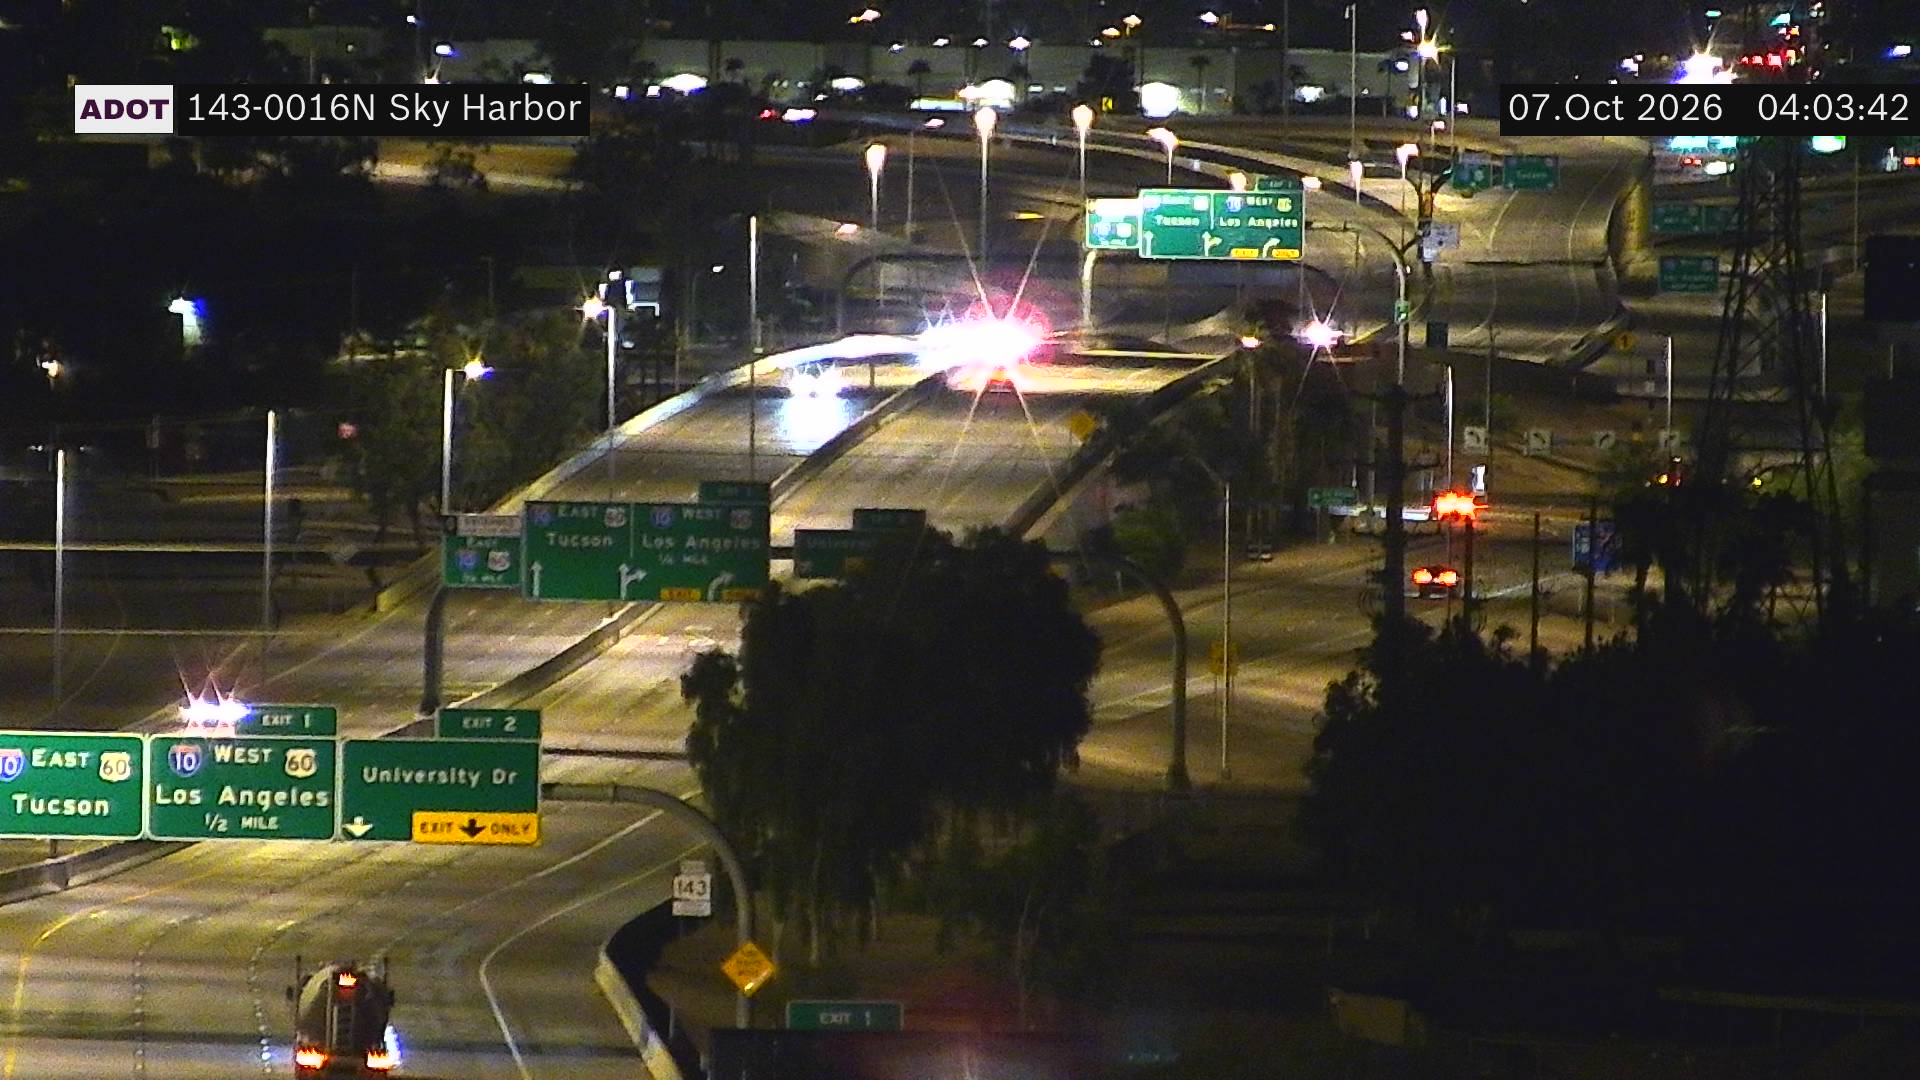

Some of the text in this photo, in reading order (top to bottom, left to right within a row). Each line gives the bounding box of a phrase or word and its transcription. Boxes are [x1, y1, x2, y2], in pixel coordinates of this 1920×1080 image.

[545, 532, 613, 547] Tucson
[642, 533, 760, 553] Los Angeles
[262, 714, 311, 727] EXIT 1
[462, 716, 517, 733] EXIT 2
[31, 748, 90, 769] EAST
[102, 760, 128, 777] 60
[175, 744, 314, 773] 10 WEST 60
[363, 766, 518, 789] University Dr
[12, 793, 110, 817] Tucson
[156, 785, 330, 813] Los Angeles
[204, 812, 280, 832] 1/2 MILE
[420, 821, 531, 836] EXIT ONLY
[678, 879, 707, 897] 143
[819, 1009, 872, 1027] EXIT 1
